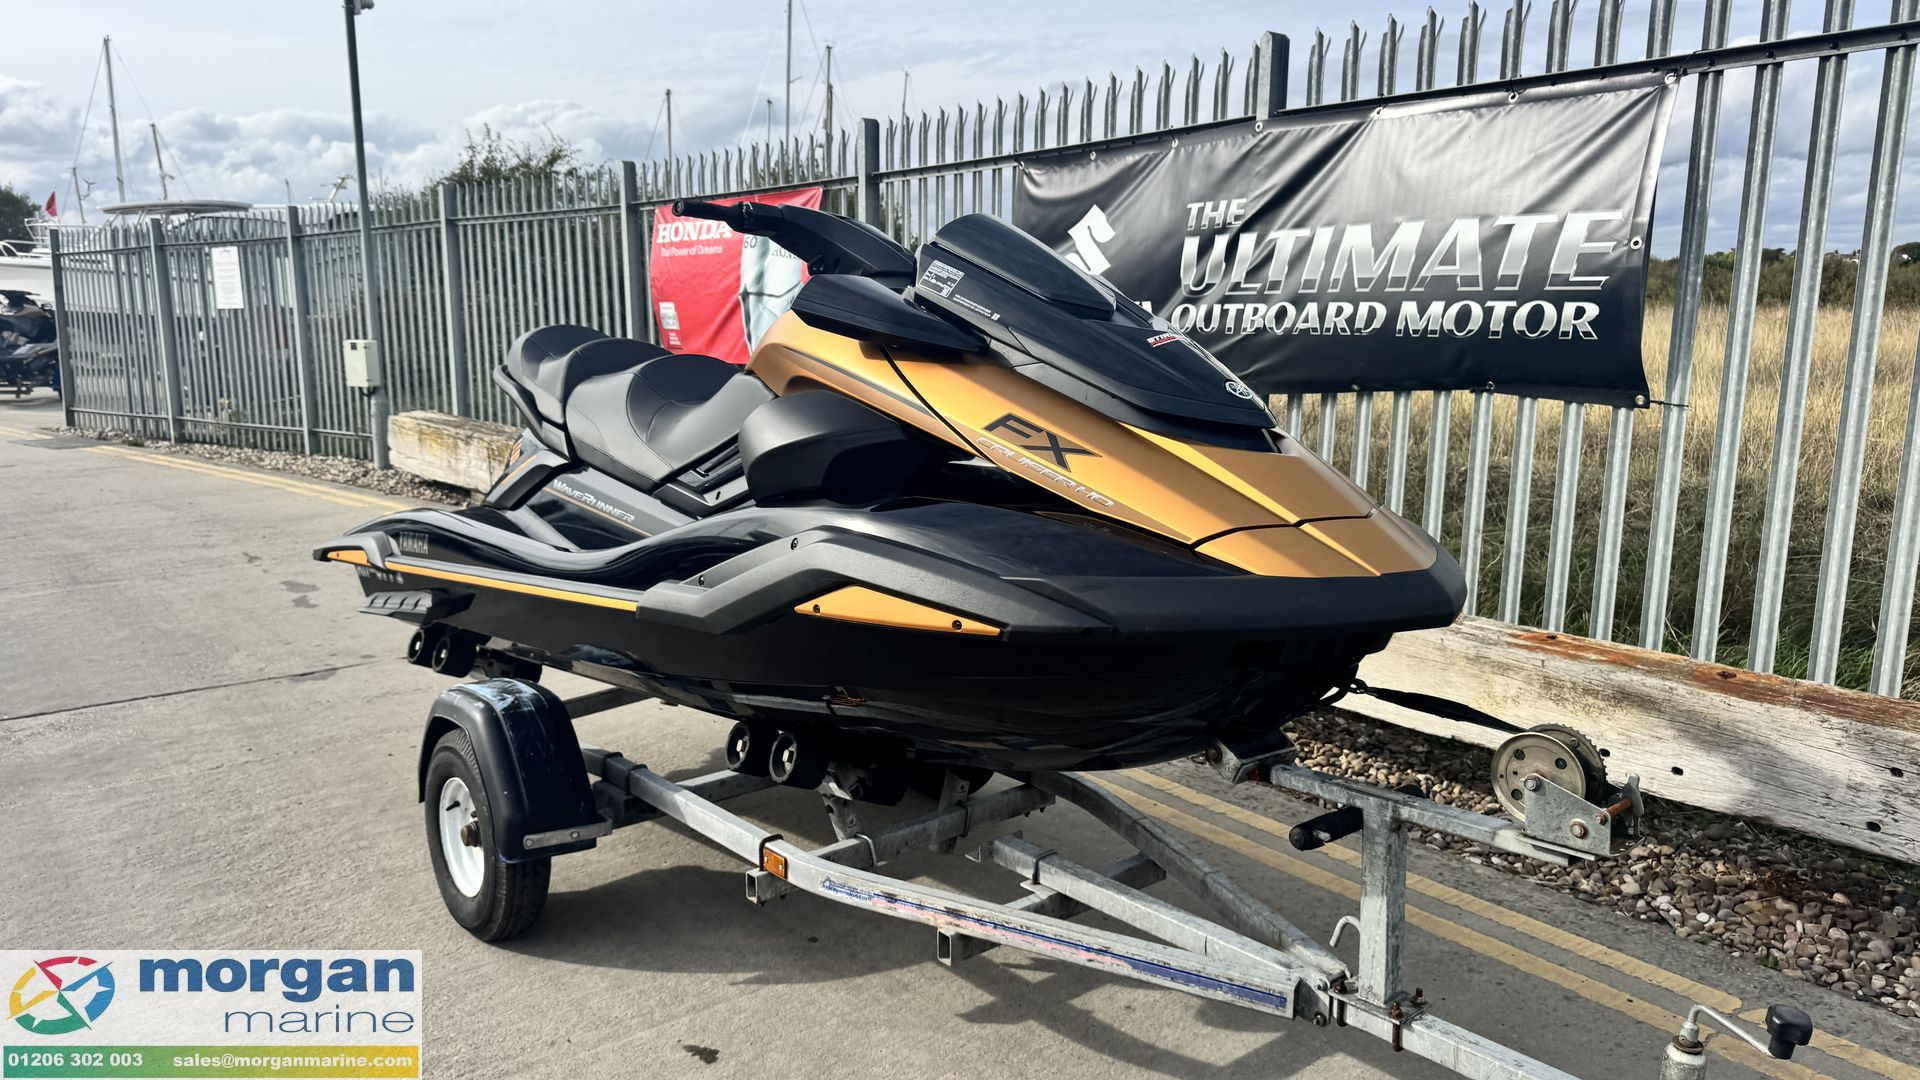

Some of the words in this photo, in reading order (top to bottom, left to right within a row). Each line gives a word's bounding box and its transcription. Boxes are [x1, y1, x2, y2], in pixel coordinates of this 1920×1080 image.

[656, 221, 732, 243] HONDA
[1186, 198, 1247, 231] THE
[661, 247, 670, 257] The
[671, 246, 689, 257] Power
[698, 243, 724, 255] Dreams
[1180, 210, 1625, 298] ULTIMATE
[1171, 301, 1388, 337] OUTBOARD
[1395, 301, 1600, 340] MOTOR
[981, 412, 1103, 473] FX
[975, 437, 1077, 489] CRUISER
